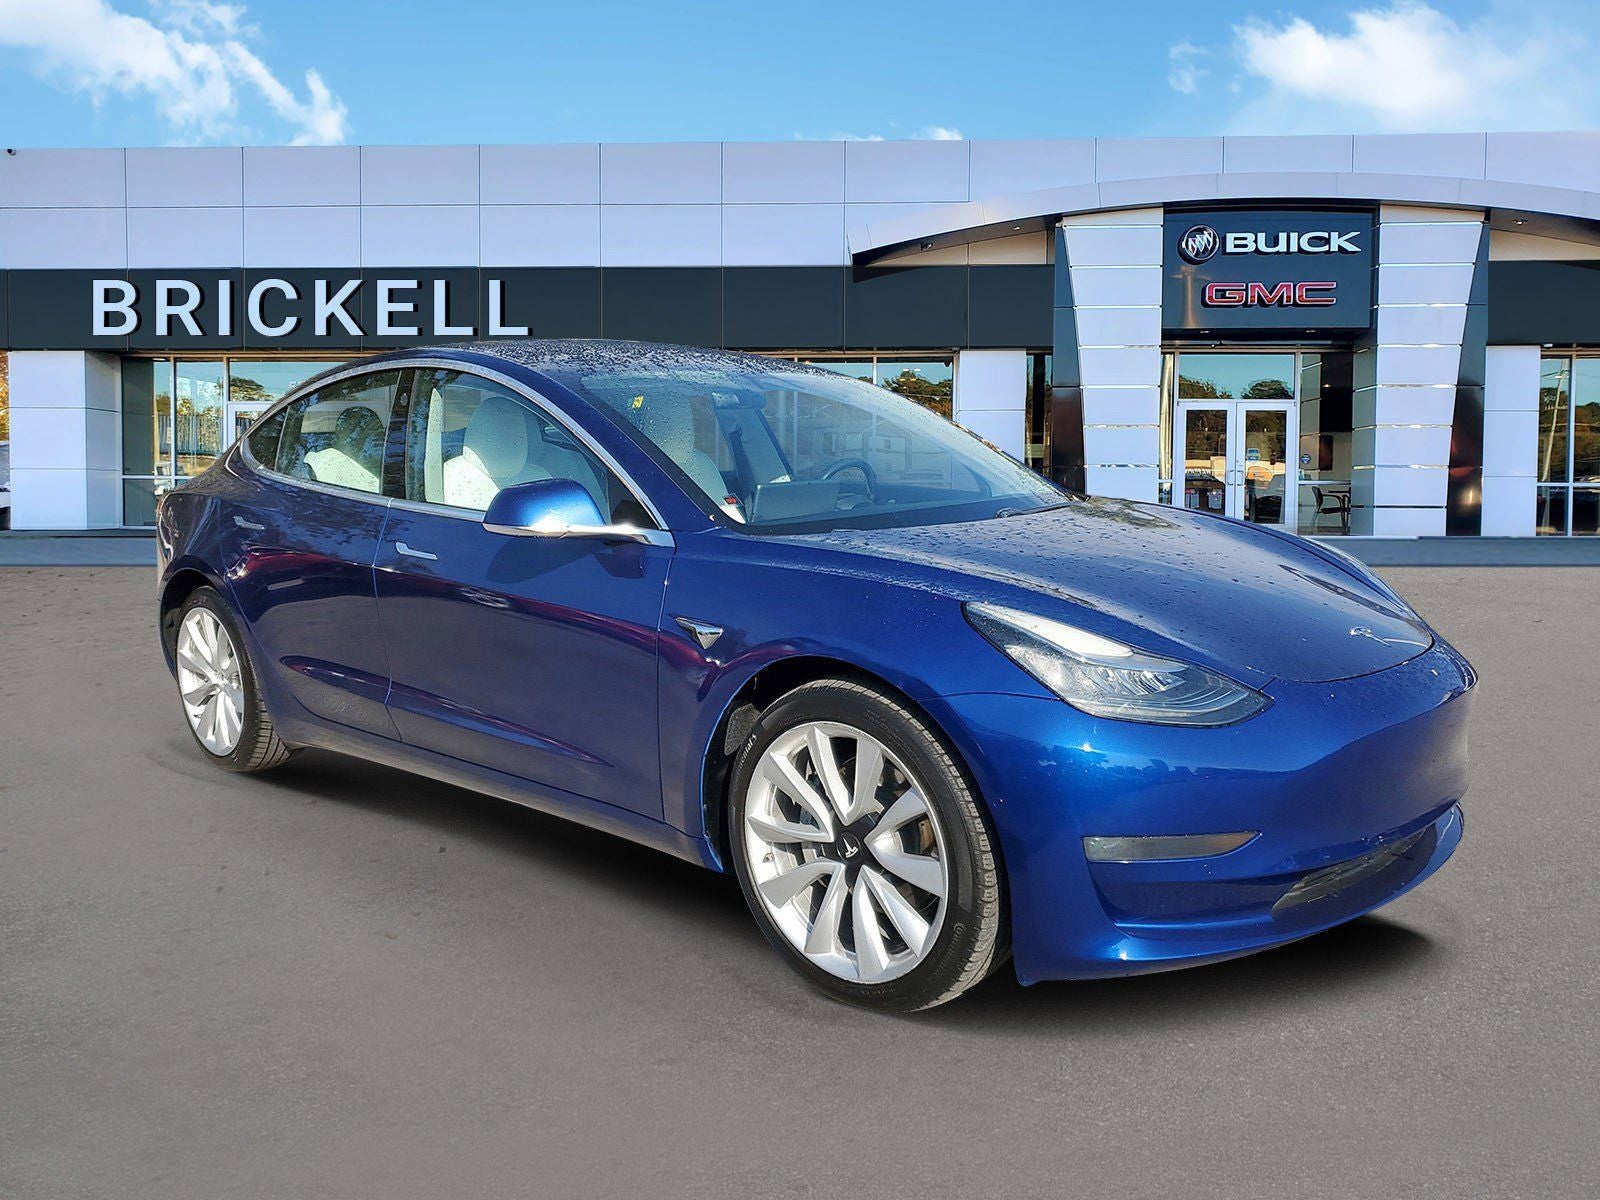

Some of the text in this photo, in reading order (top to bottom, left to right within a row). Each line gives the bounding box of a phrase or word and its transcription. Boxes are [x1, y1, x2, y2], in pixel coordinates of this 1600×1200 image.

[1225, 231, 1362, 253] BUICK
[1205, 281, 1337, 306] GMC
[91, 278, 531, 337] BRICKELL
